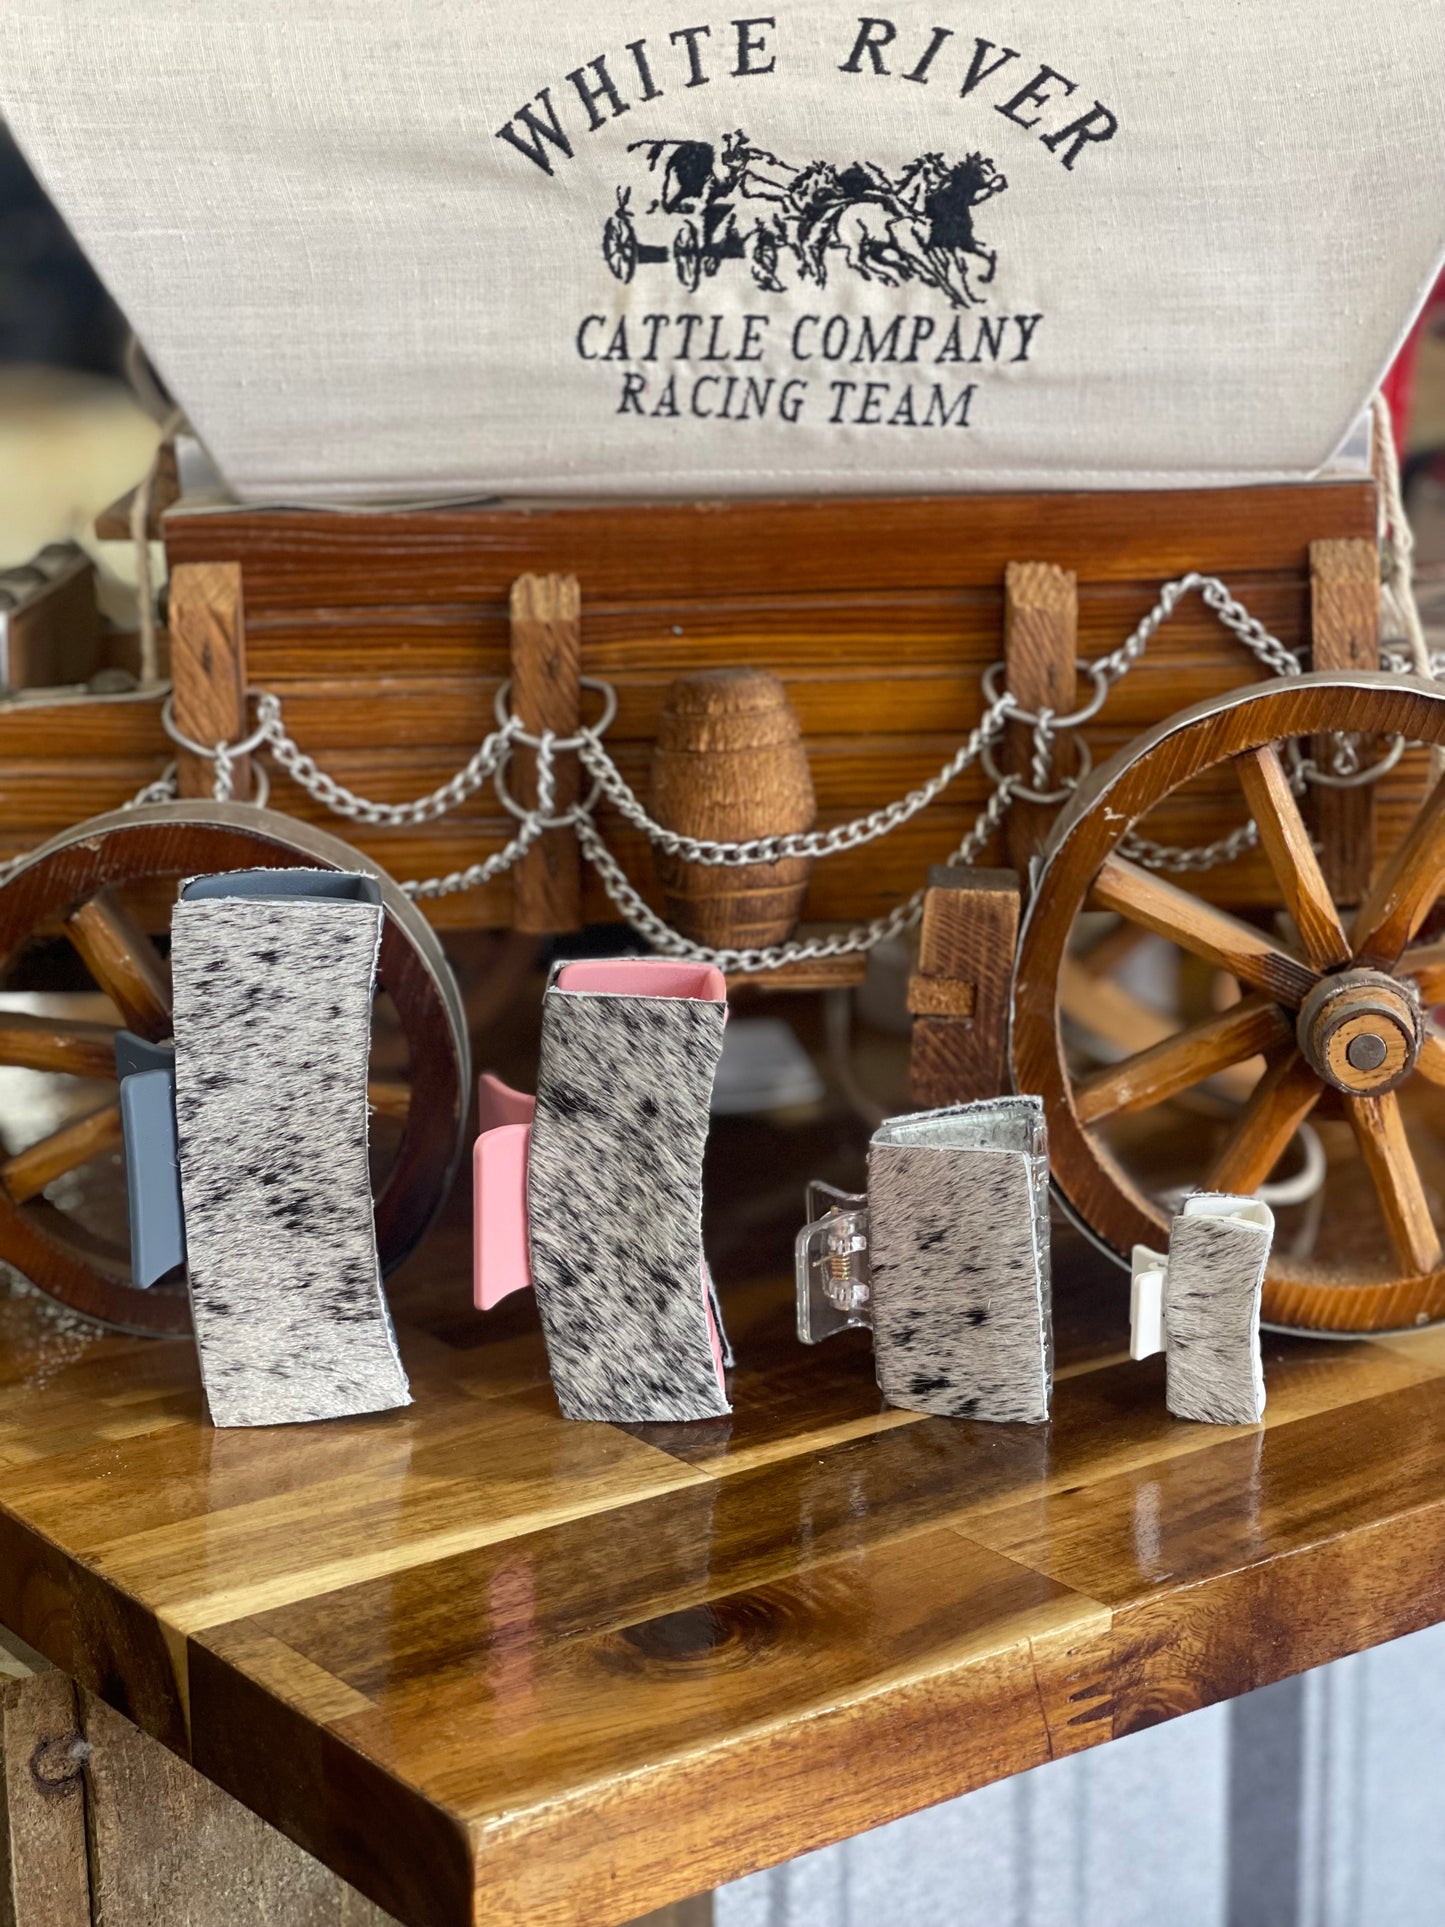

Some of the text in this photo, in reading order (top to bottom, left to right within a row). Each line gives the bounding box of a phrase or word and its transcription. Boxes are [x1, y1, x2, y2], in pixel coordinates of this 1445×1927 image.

[495, 17, 1118, 177] WHITE RIVER
[576, 314, 1043, 363] CATTLE COMPANY
[616, 372, 978, 428] RACING TEAM
